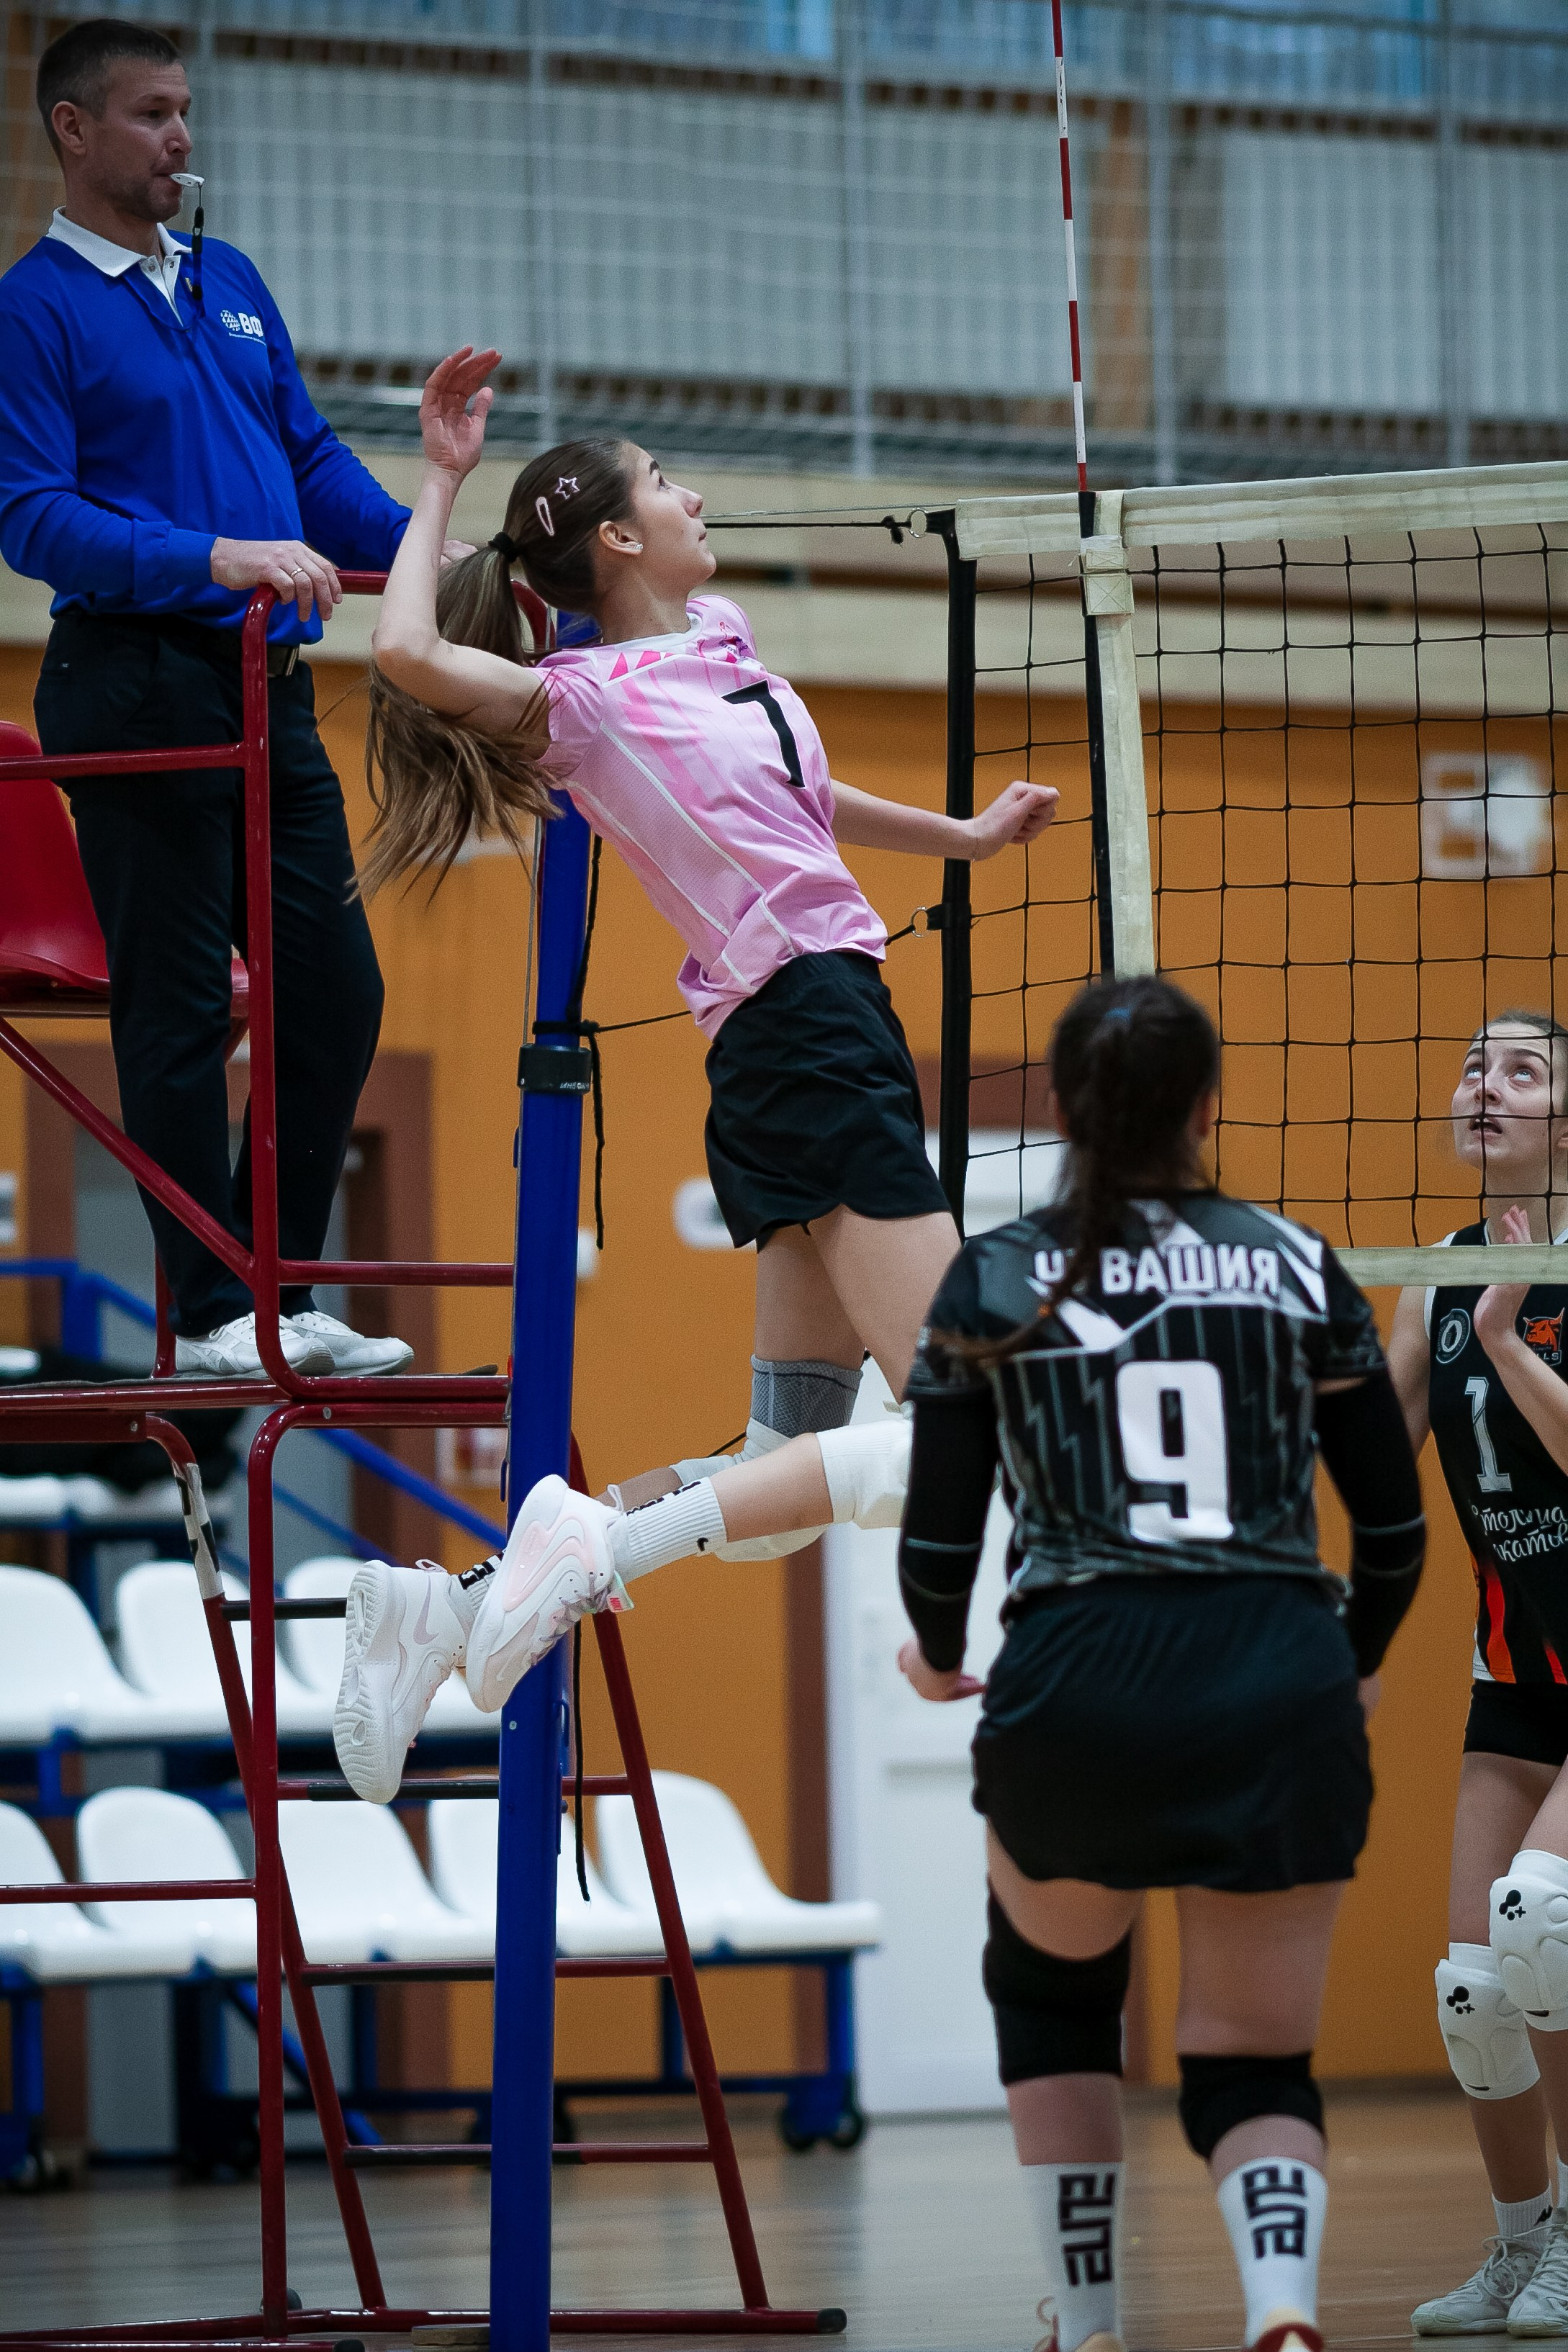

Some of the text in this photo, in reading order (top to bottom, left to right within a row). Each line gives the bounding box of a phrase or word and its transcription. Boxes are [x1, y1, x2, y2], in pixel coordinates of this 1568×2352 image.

[721, 679, 806, 789] 7
[1033, 1243, 1279, 1296] ЧВАШИЯ
[1117, 1360, 1234, 1542] 9
[1464, 1376, 1513, 1492] 1
